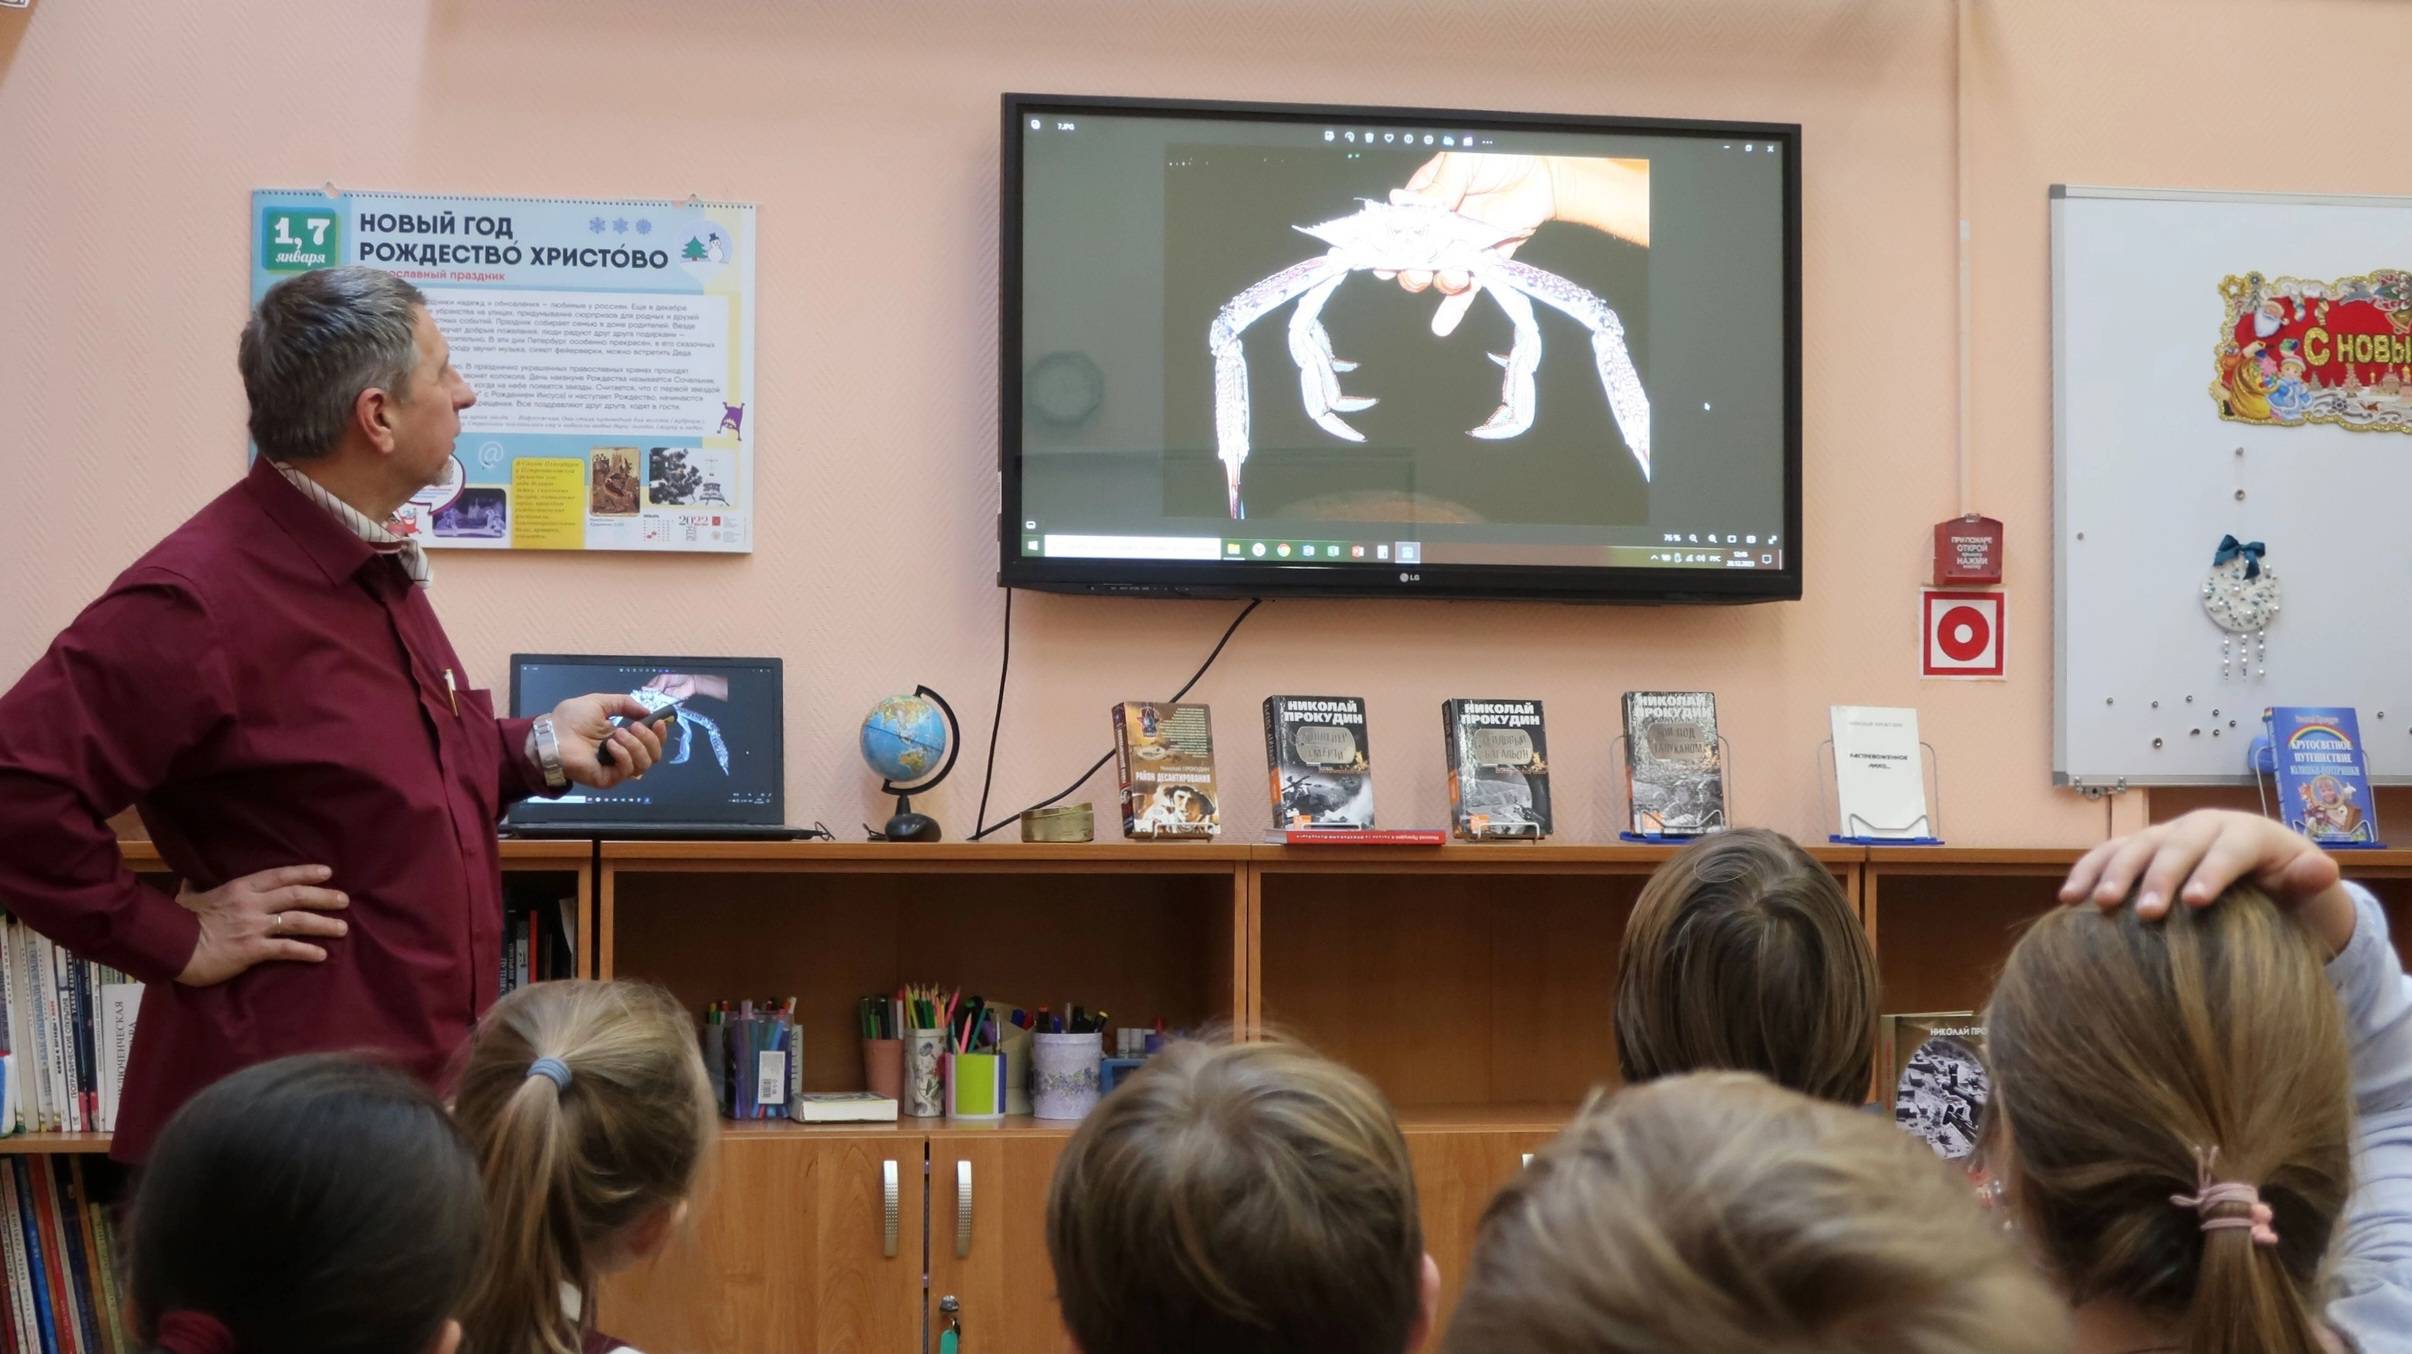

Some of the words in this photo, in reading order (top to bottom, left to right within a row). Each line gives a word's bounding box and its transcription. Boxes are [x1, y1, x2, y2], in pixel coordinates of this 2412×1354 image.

[307, 218, 331, 246] 7
[359, 211, 455, 235] НОВЫЙ
[464, 216, 513, 240] ГОД
[274, 248, 326, 267] января
[389, 272, 448, 284] ославный
[2303, 327, 2331, 366] С
[1288, 700, 1358, 713] НИКОЛАЙ
[1464, 702, 1535, 714] НИКОЛАЙ
[1284, 711, 1363, 726] ПРОКУДИН
[1460, 714, 1541, 728] ПРОКУДИН
[62, 997, 73, 1034] ОТКРЫТИЯ
[1930, 1026, 1970, 1036] НИКОЛАЙ
[66, 1034, 79, 1100] ГЕОГРАФИЧЕСКИЕ
